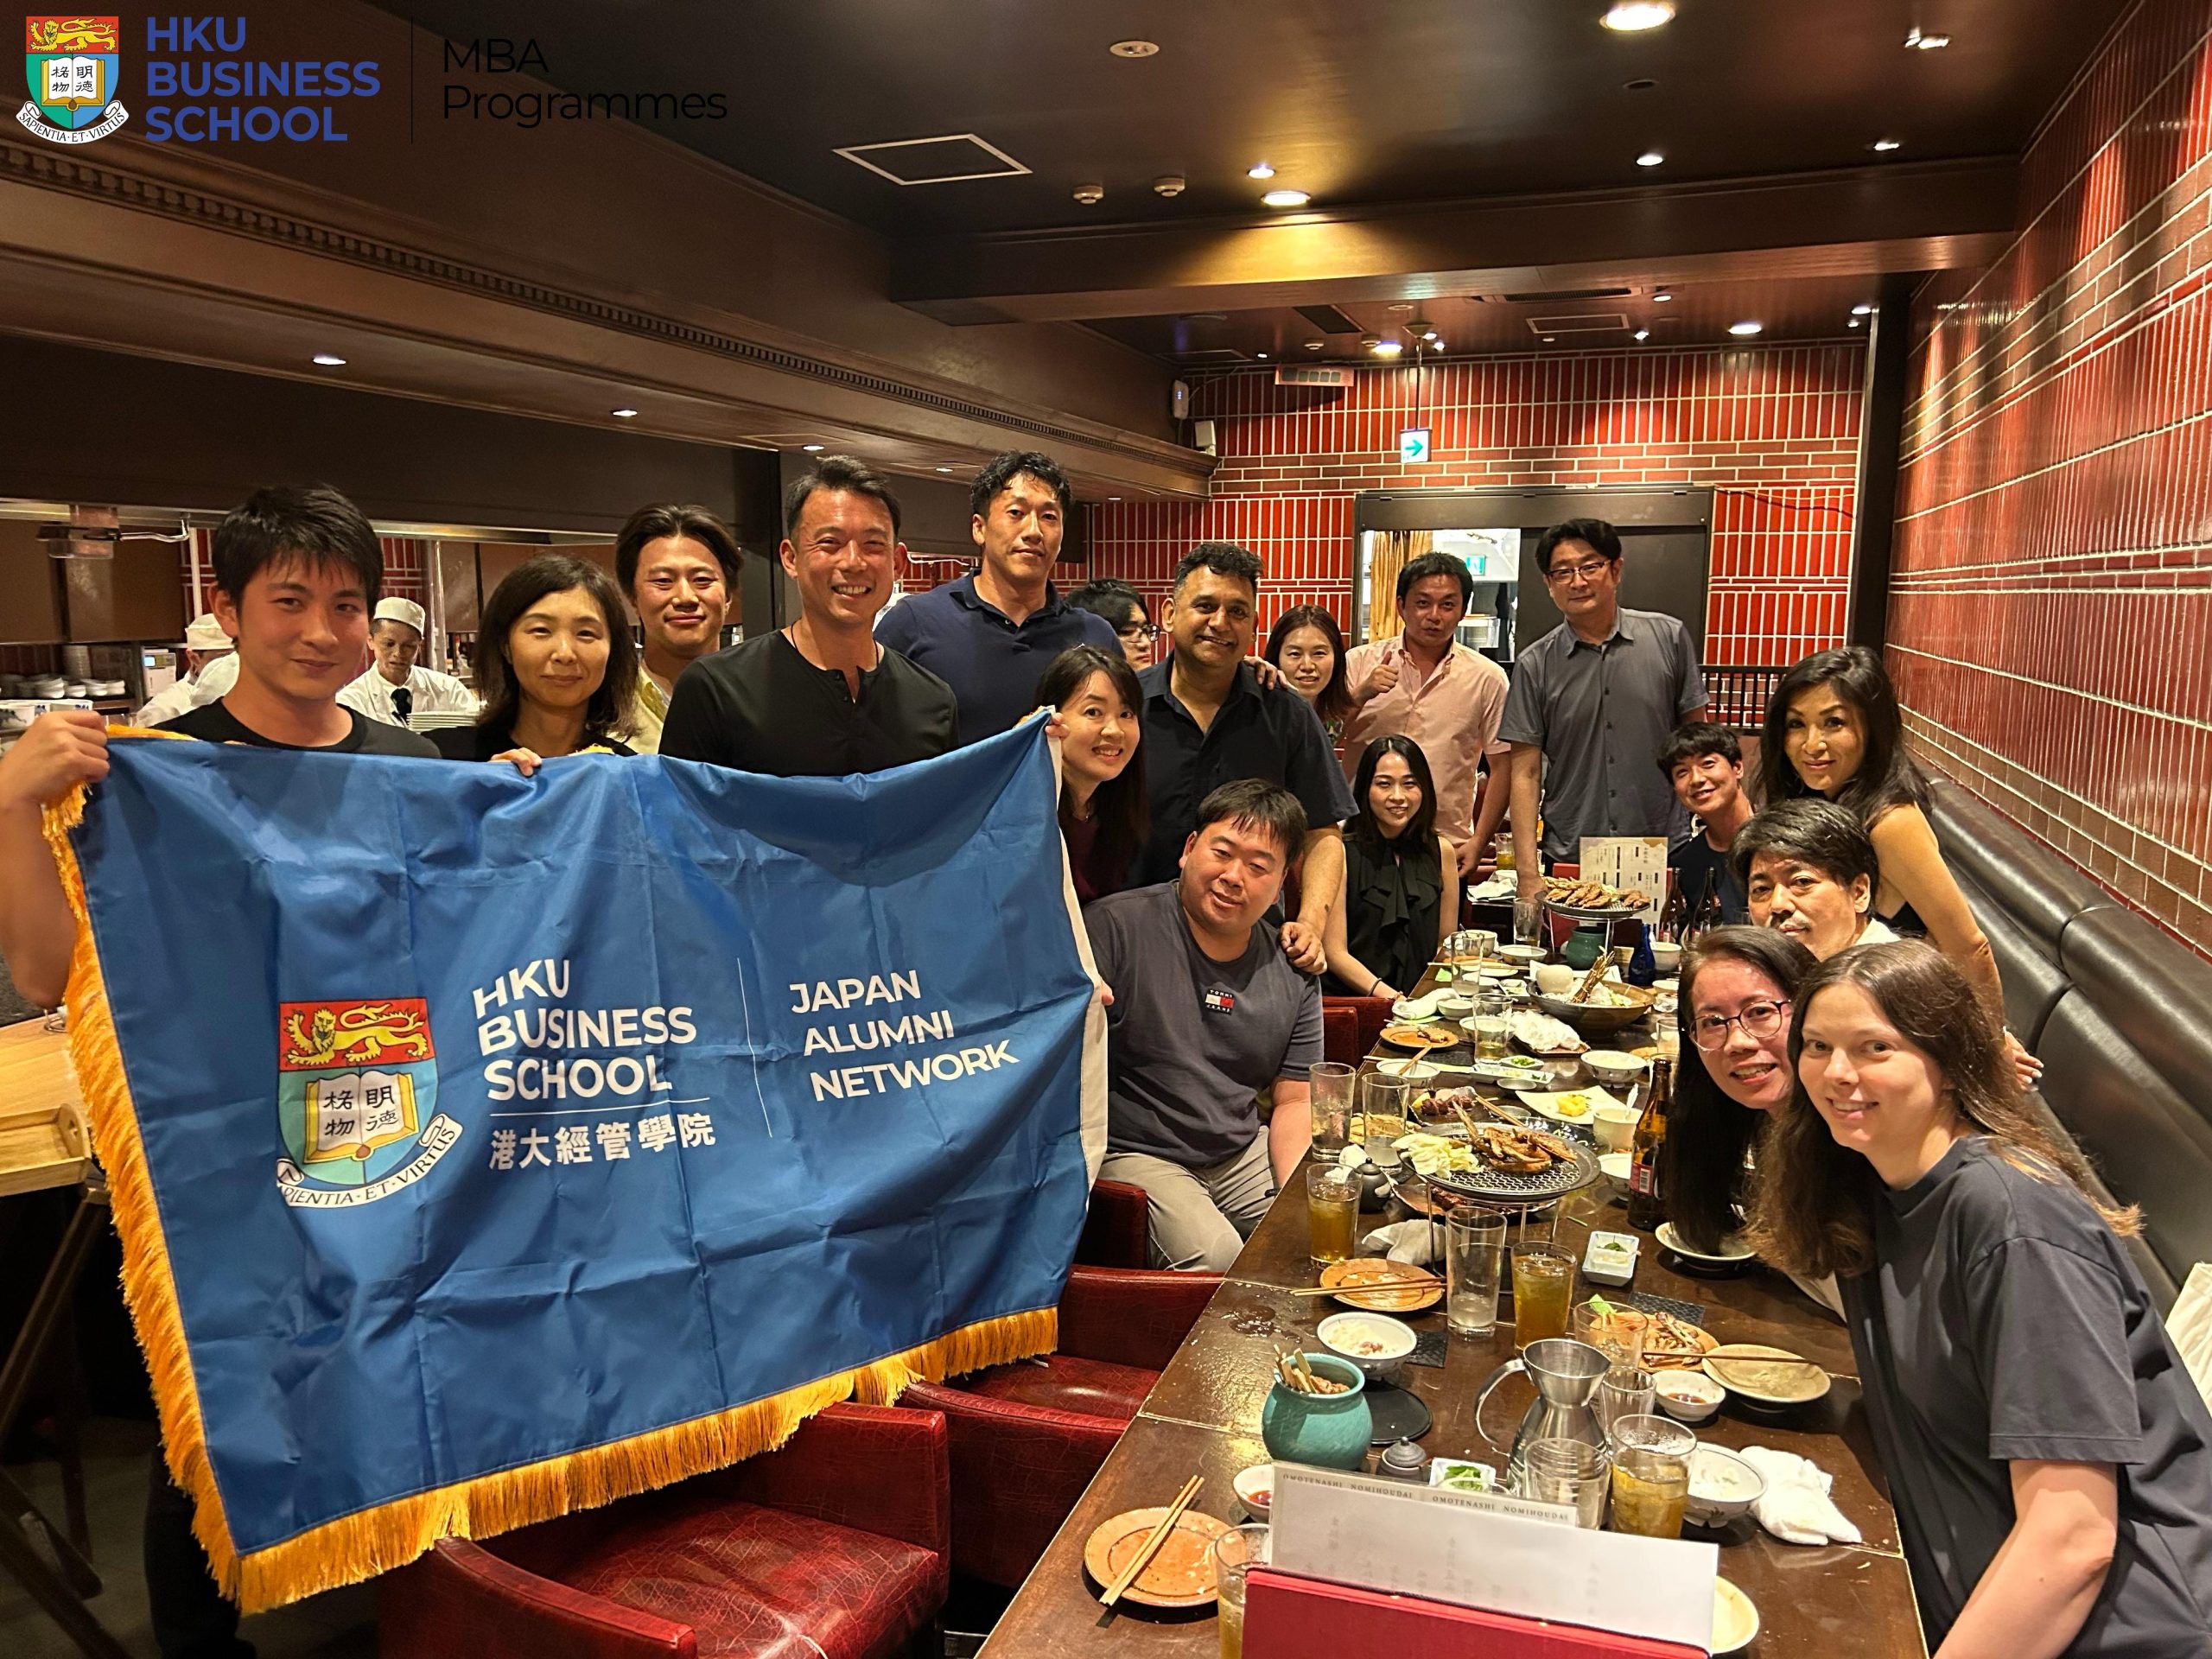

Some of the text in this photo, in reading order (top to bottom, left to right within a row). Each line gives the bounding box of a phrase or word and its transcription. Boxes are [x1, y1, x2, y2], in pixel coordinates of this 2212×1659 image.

[472, 959, 570, 1020] HKU
[789, 969, 922, 1014] JAPAN
[477, 1007, 697, 1056] BUSINESS
[804, 1009, 955, 1056] ALUMNI
[482, 1055, 673, 1101] SCHOOL
[810, 1039, 1021, 1102] NETWORK
[365, 1181, 391, 1201] ET
[397, 1128, 456, 1184] VIRTUS
[488, 1112, 717, 1171] 港大經管學院
[1282, 1473, 1414, 1499] OMOTENASHI NOMIHOUDAI
[1432, 1495, 1569, 1521] OMOTENASHI NOMIHOUDAI
